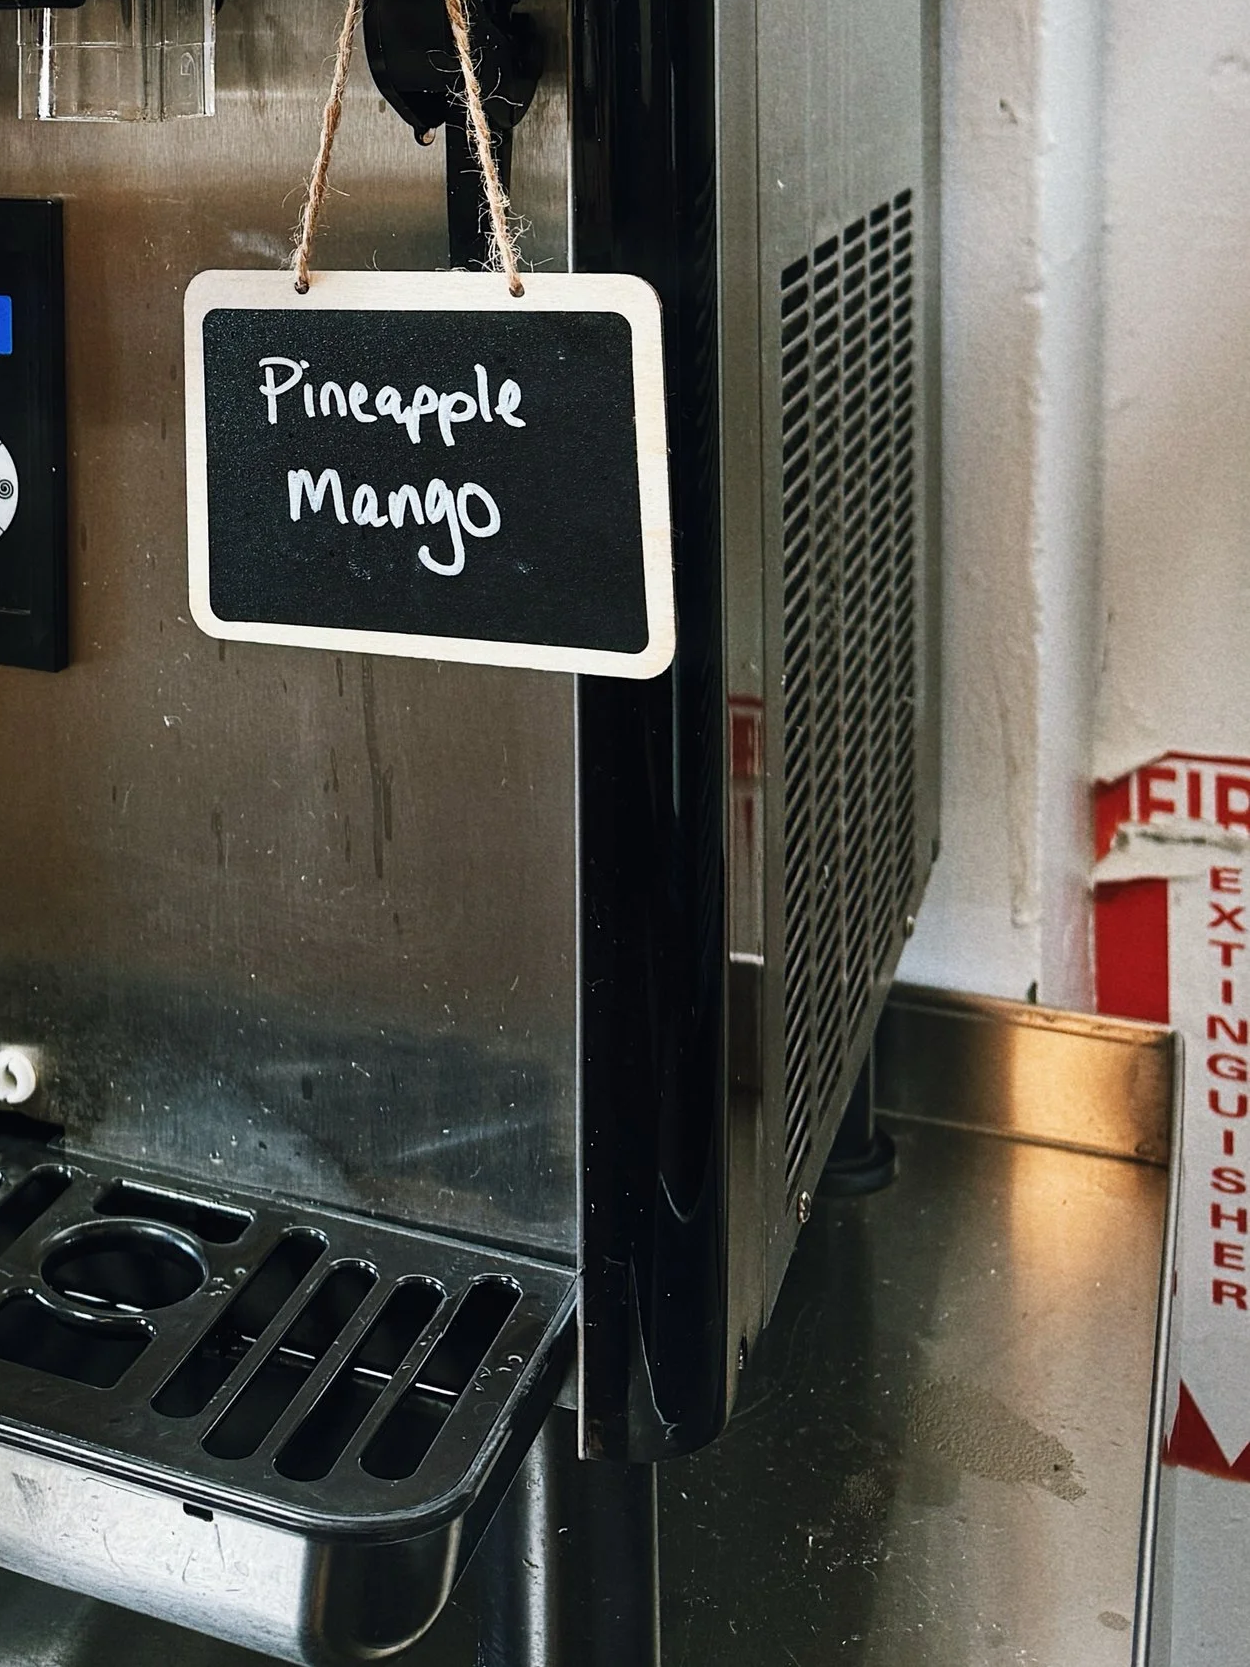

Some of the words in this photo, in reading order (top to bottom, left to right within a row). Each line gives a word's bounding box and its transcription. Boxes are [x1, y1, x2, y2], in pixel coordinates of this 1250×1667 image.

[258, 356, 527, 446] Pineapple
[286, 466, 502, 577] Mango
[1206, 866, 1248, 1311] EXTINGUISHER
